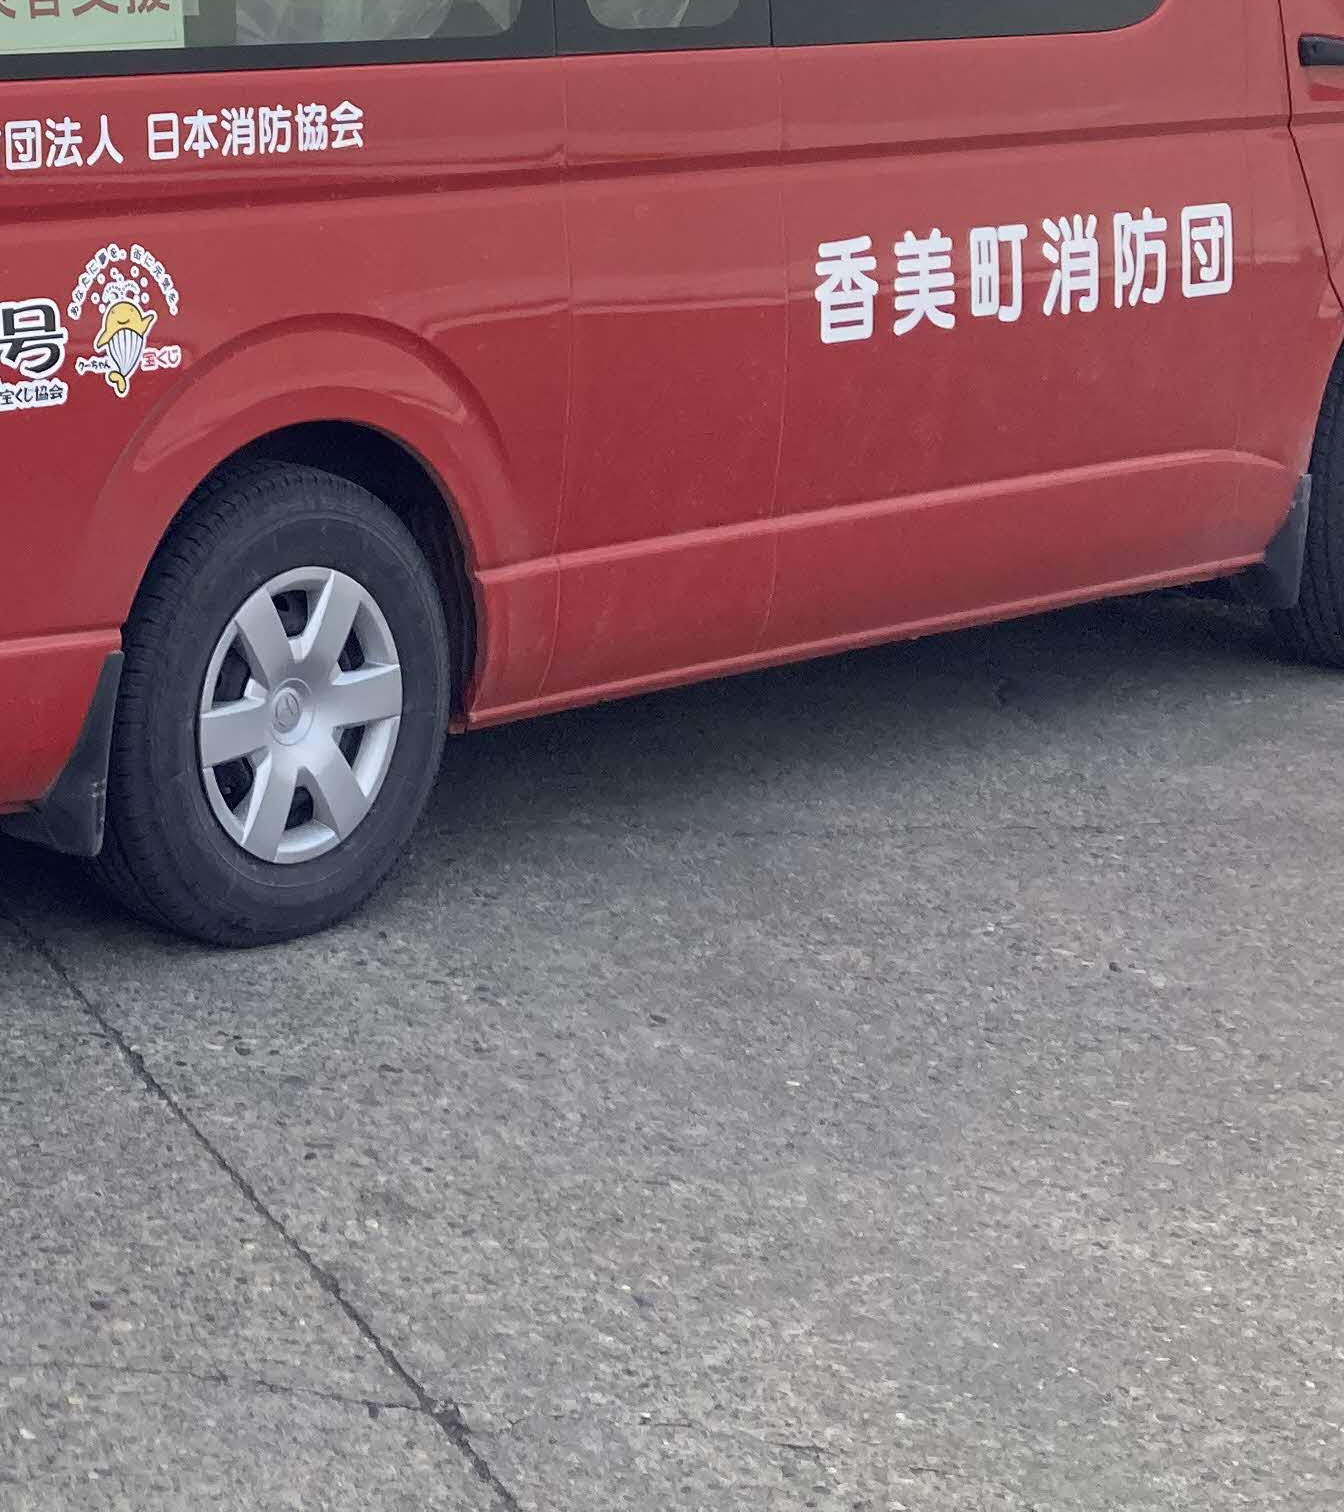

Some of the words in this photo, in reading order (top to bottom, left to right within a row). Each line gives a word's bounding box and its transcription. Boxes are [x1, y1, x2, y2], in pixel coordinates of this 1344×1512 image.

[147, 101, 365, 159] 日本消防協会
[815, 202, 1232, 344] 香美町消防団
